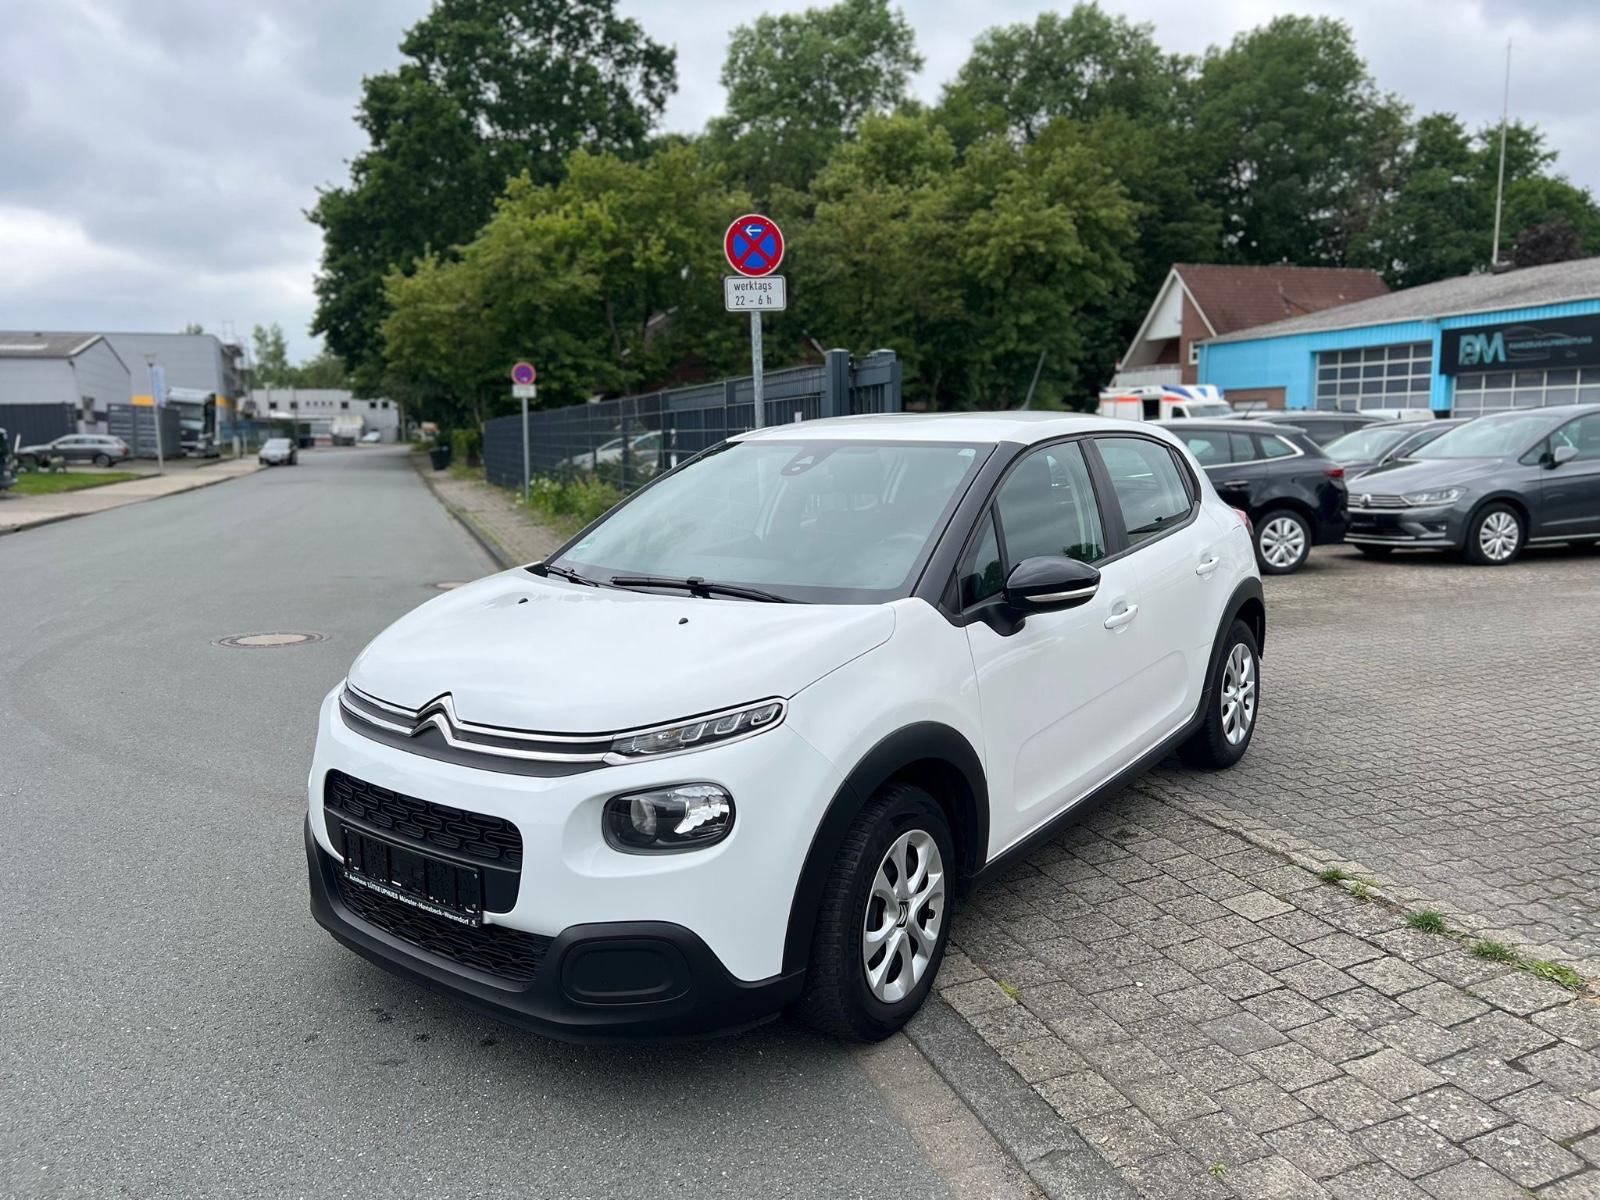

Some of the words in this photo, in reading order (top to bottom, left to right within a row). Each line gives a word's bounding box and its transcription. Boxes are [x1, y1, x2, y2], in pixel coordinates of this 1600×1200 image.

[733, 281, 773, 293] werktags
[735, 295, 745, 306] 22
[758, 295, 763, 305] 6
[766, 295, 772, 305] h
